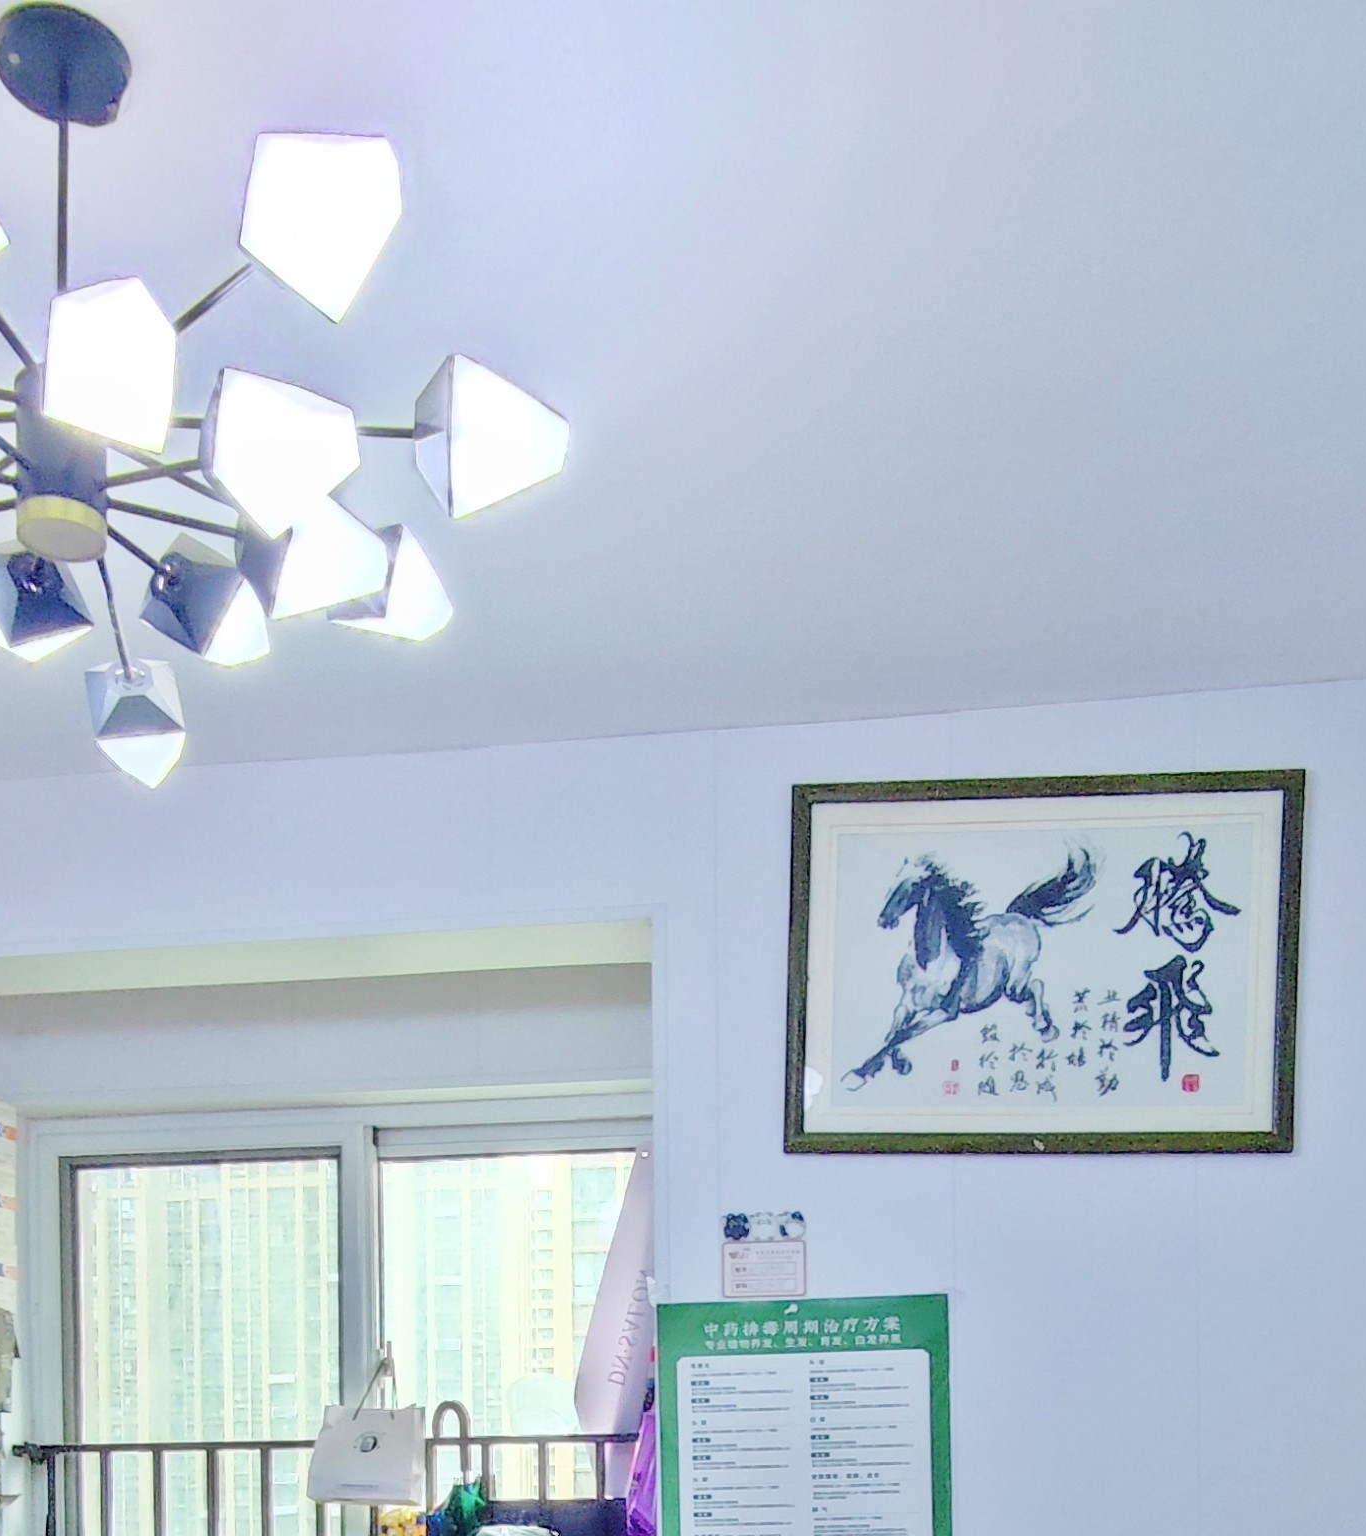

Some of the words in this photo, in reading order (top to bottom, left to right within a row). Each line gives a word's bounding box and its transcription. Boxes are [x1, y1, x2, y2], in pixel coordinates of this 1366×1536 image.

[703, 1316, 902, 1338] 中药排毒周期治疗方案
